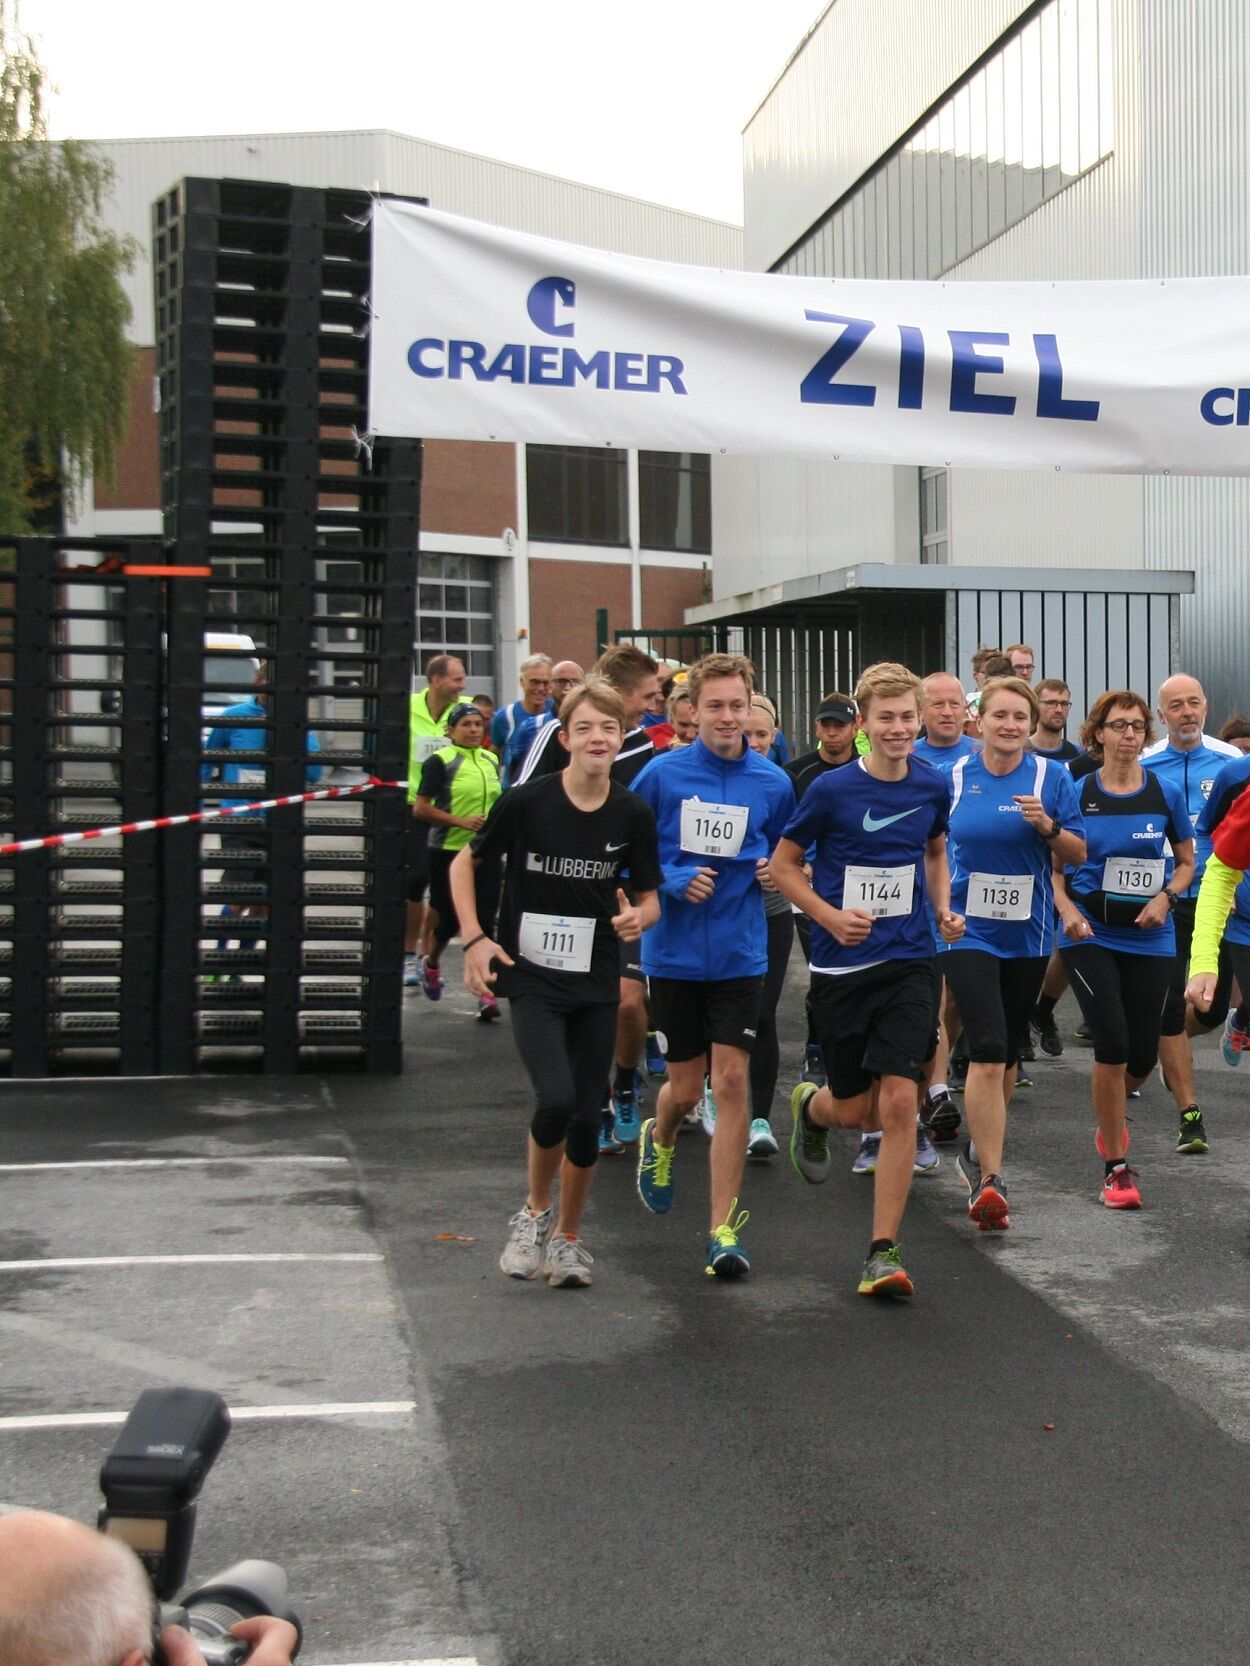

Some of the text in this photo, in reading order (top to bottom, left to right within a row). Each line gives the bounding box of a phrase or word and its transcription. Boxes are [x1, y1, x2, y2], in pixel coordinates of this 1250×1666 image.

[407, 337, 689, 396] CRAEMER
[800, 308, 1101, 422] ZIEL
[696, 818, 733, 840] 1160
[1117, 870, 1153, 888] 1130
[860, 882, 902, 901] 1144
[982, 887, 1020, 906] 1138
[543, 931, 575, 953] 1111
